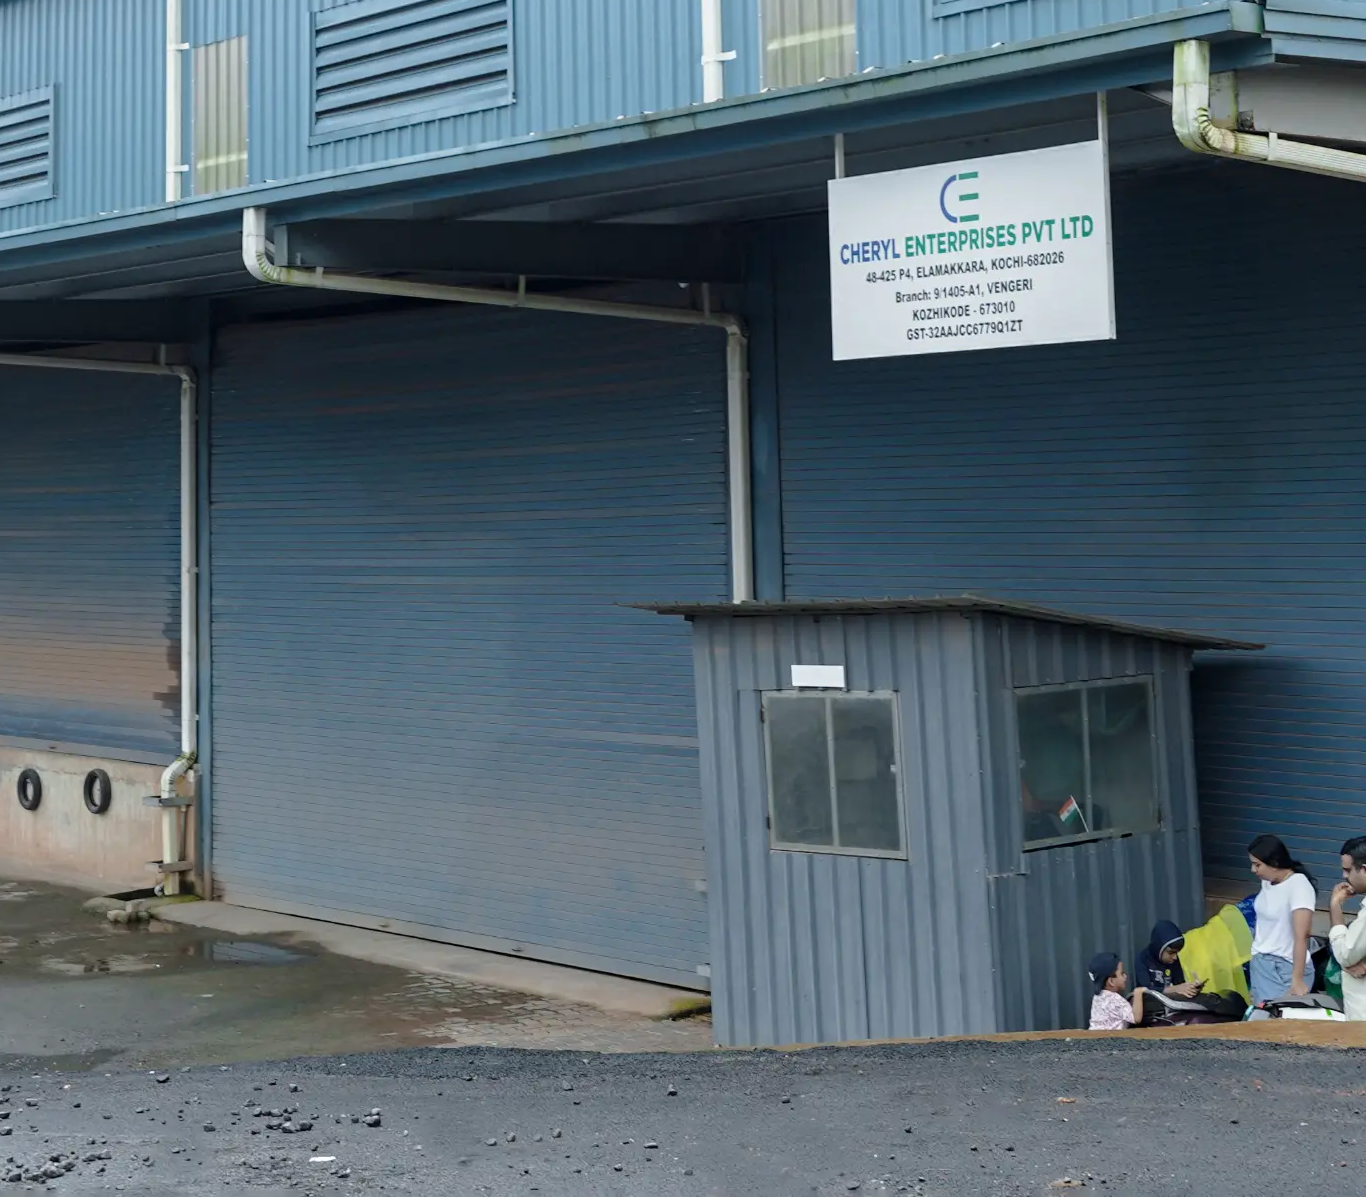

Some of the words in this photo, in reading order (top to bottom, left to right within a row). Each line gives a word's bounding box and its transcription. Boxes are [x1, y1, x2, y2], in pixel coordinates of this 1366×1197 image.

[840, 238, 901, 265] CHERYL
[904, 223, 1017, 258] ENTERPRISES
[1021, 218, 1056, 244] PVT
[1060, 214, 1094, 240] LTD
[865, 269, 897, 283] 48-425
[899, 267, 914, 281] P4,
[916, 259, 988, 279] ELAMAKKARA,
[991, 250, 1065, 271] KOCHI-682026
[895, 289, 932, 303] Branch:
[986, 278, 1033, 294] VENGERI
[912, 304, 971, 321] KOZHIKODE
[979, 300, 1016, 315] 673010
